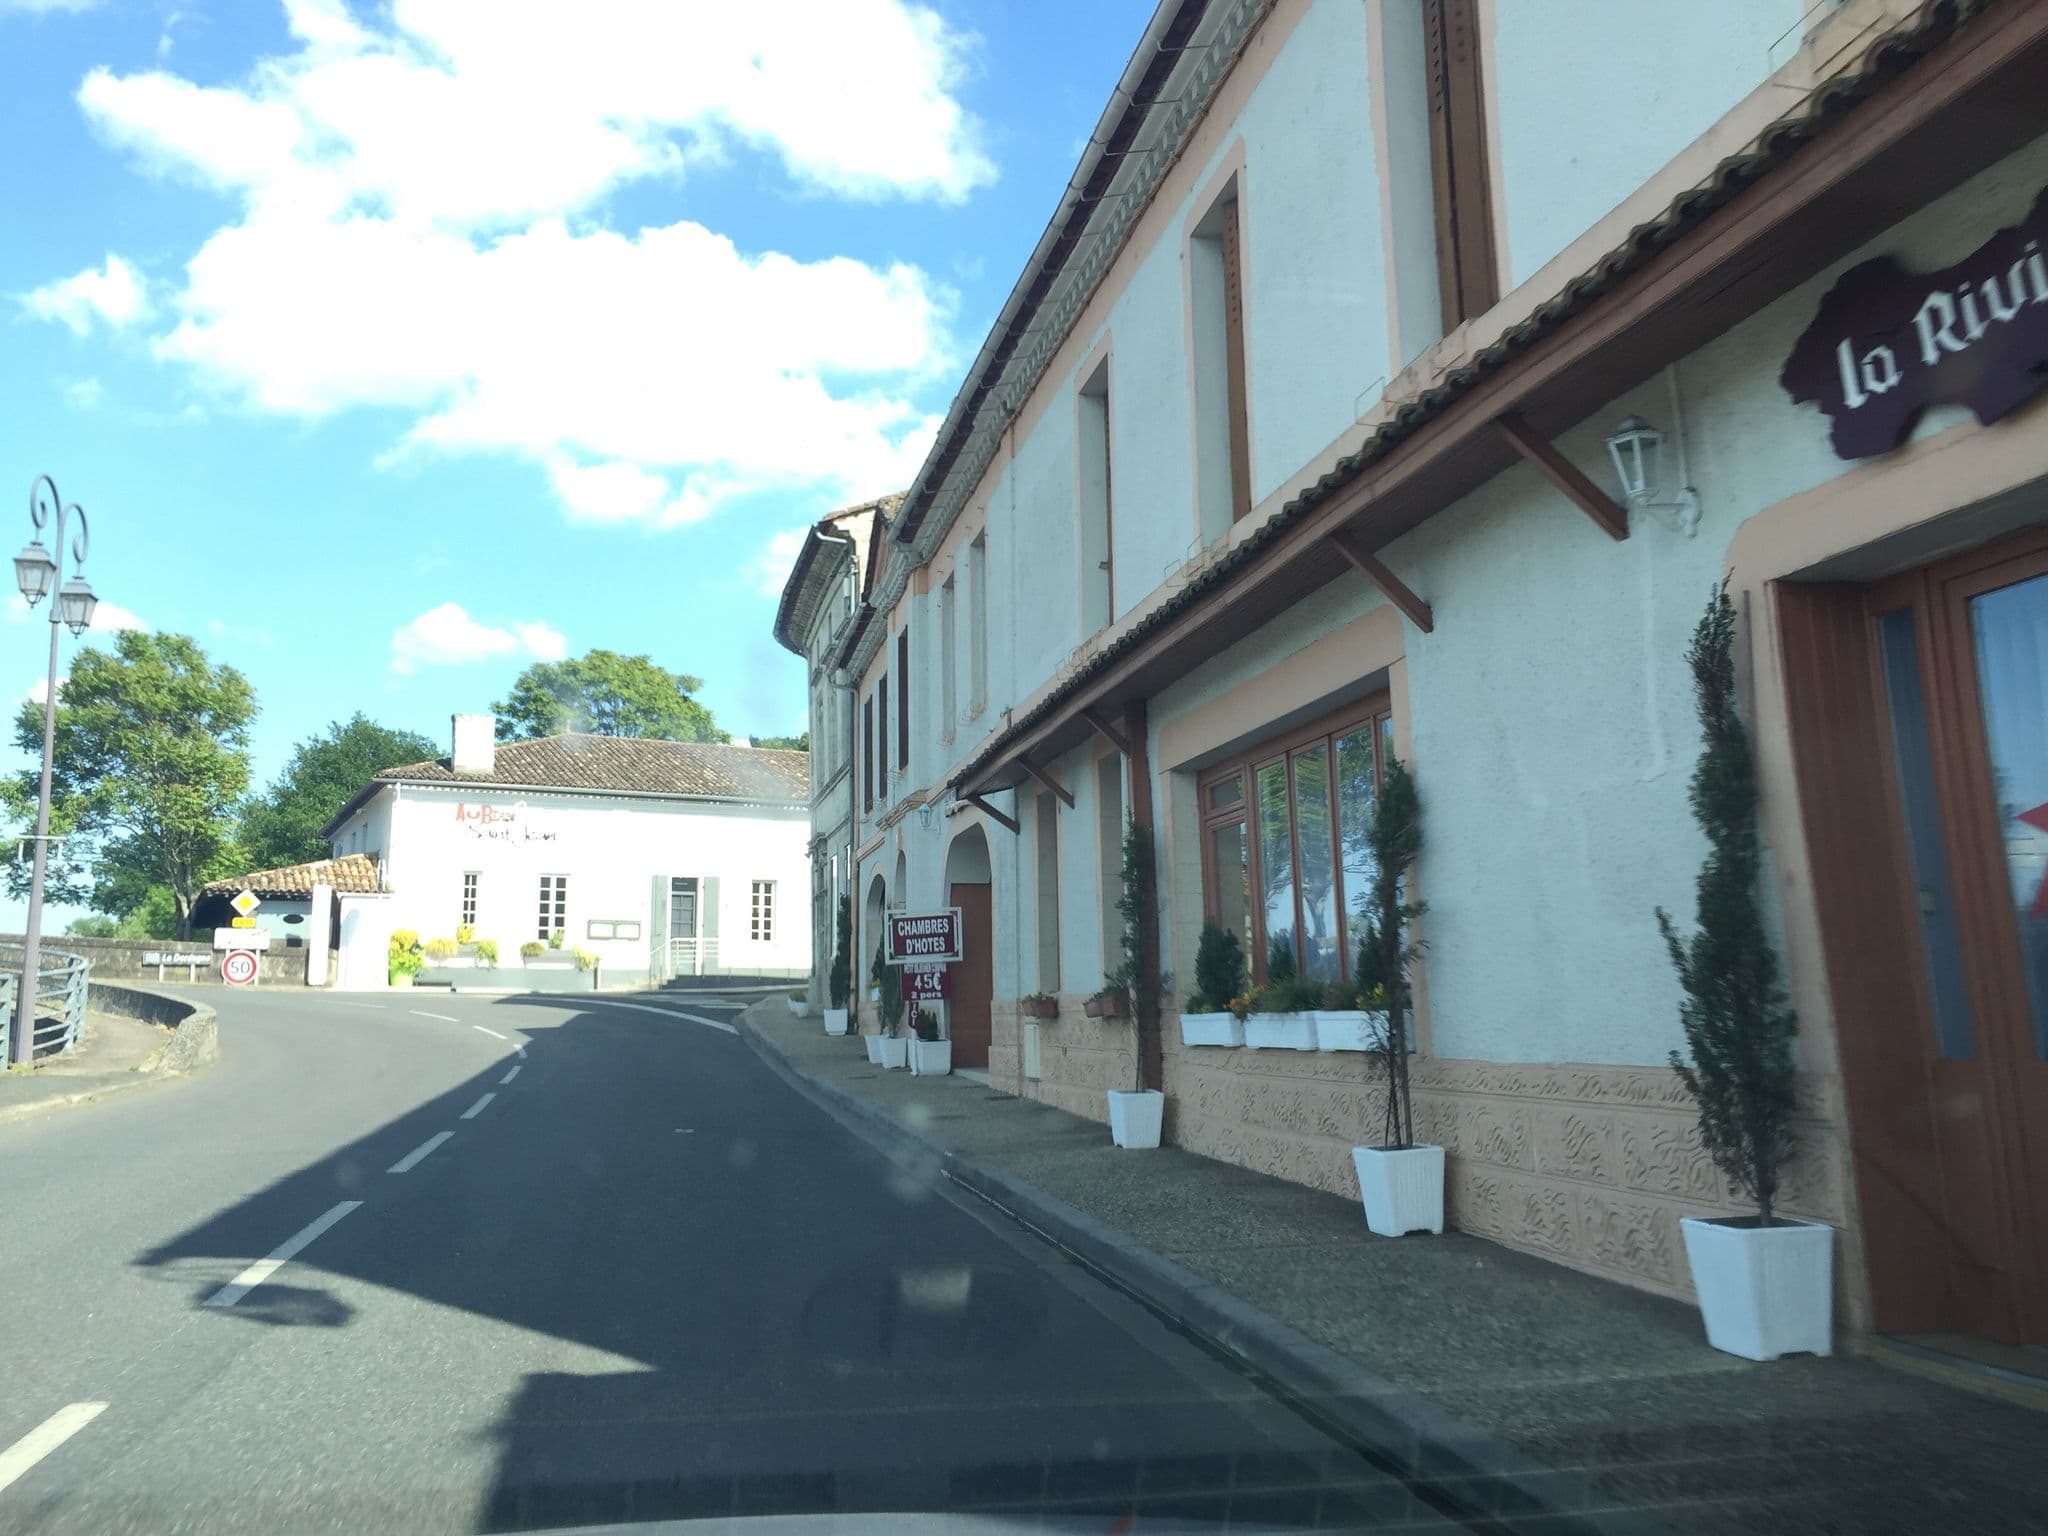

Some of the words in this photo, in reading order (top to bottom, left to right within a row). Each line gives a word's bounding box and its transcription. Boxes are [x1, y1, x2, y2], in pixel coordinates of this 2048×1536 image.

[898, 918, 949, 936] CHAMBRES
[906, 936, 945, 954] D'HOTES
[230, 960, 250, 975] 50
